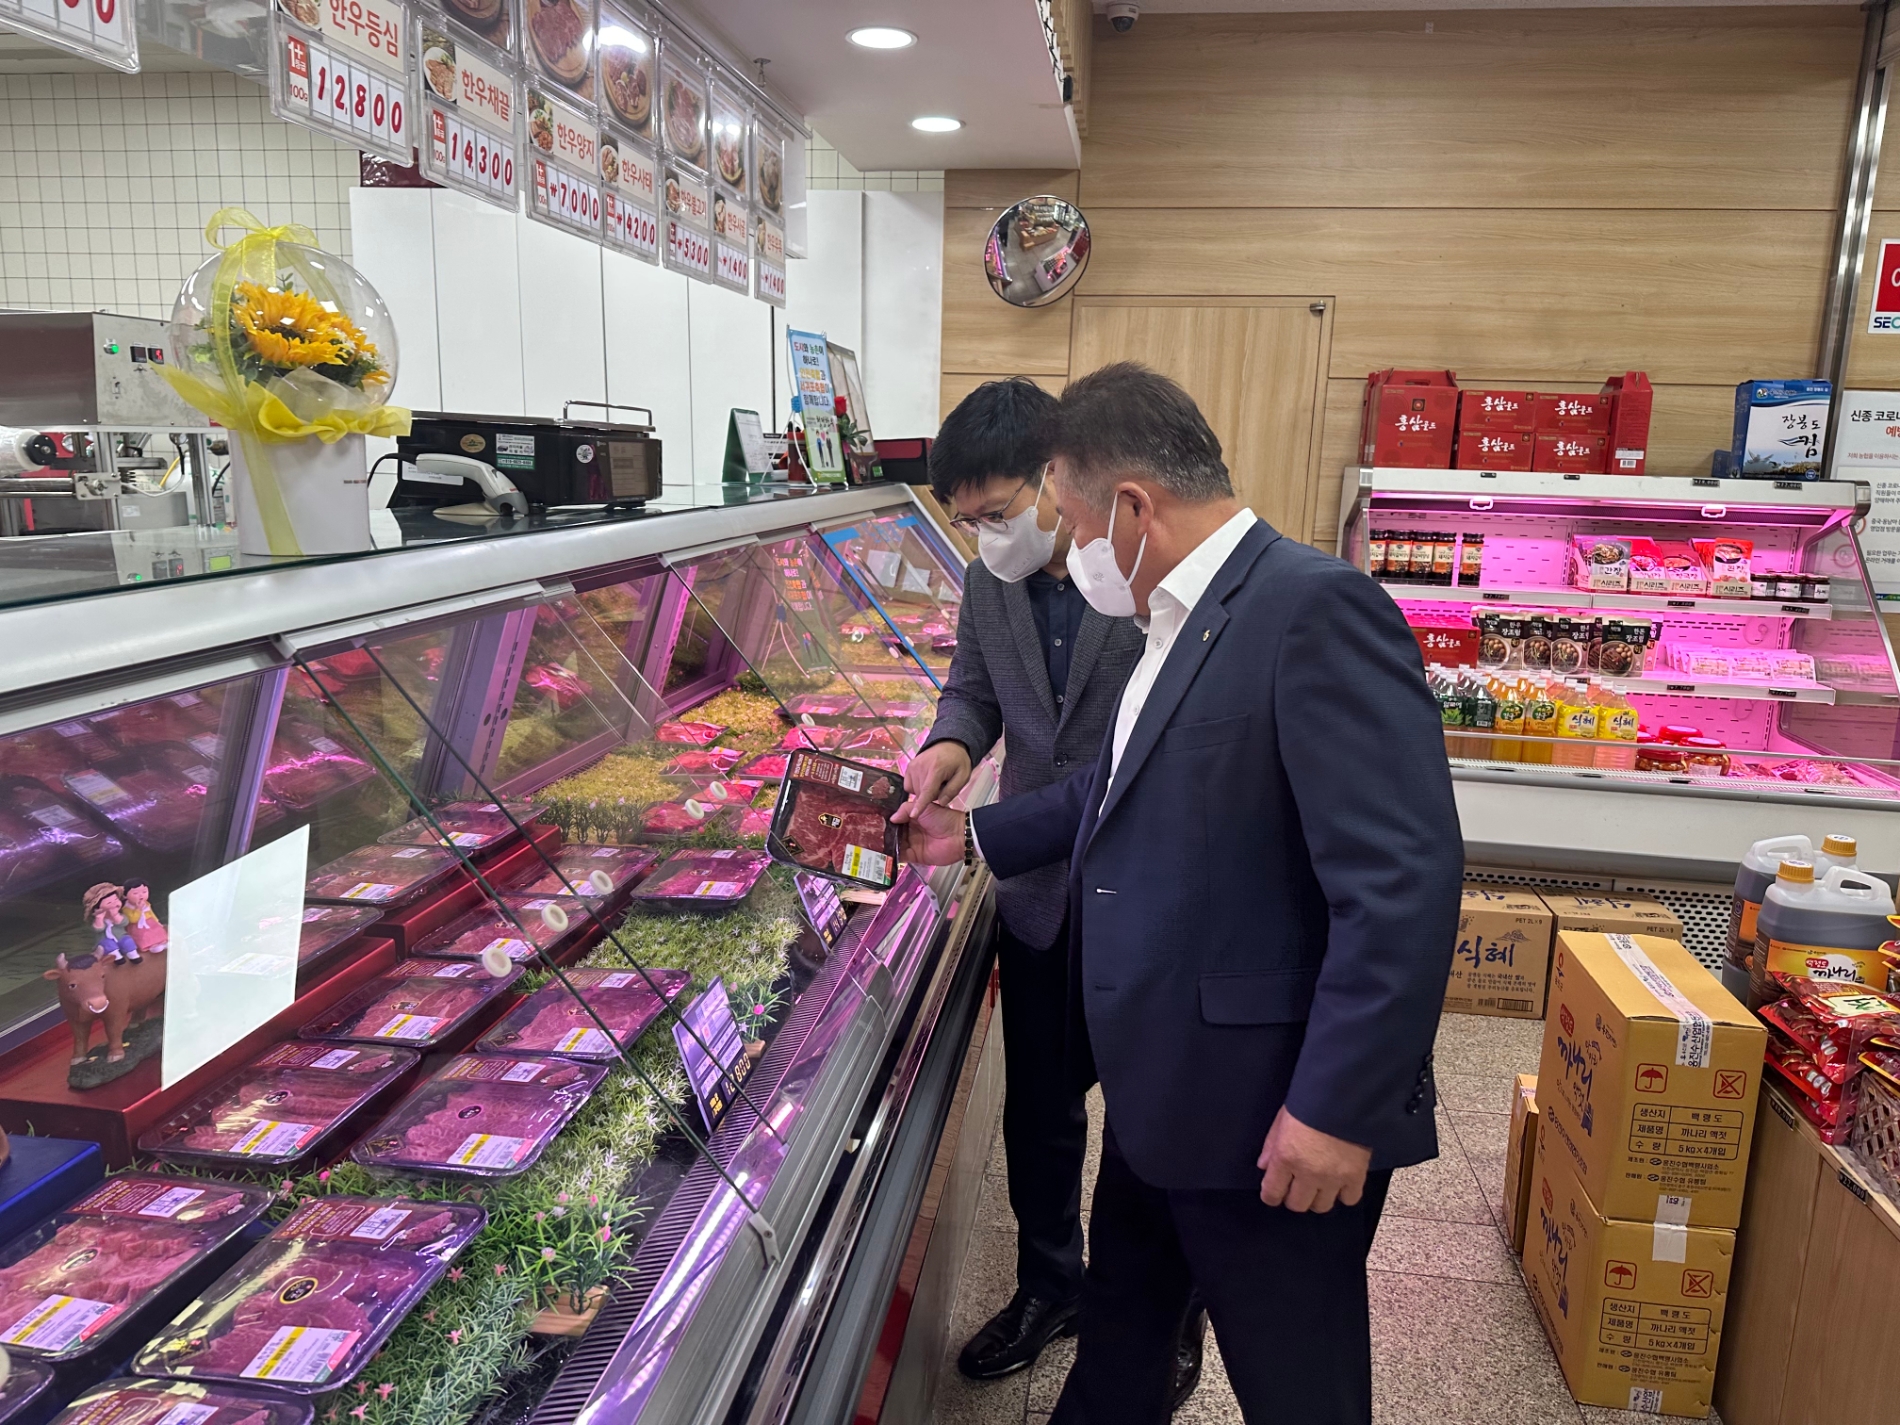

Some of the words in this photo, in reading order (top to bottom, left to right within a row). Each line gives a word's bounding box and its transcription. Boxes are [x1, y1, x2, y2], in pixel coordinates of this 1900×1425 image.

[461, 69, 510, 122] 한우채끝
[556, 122, 595, 165] 한우양지
[622, 157, 653, 195] 한우사태
[1782, 414, 1821, 430] 장봉도
[1850, 410, 1872, 422] 신종
[1798, 433, 1818, 459] 김
[1572, 714, 1596, 727] 식혜
[1612, 714, 1635, 727] 식혜
[1456, 935, 1516, 969] 식혜
[1813, 966, 1857, 982] 까나리
[1640, 1107, 1666, 1119] 생산지
[1637, 1123, 1664, 1135] 제품명
[1681, 1127, 1707, 1138] 까나리
[1709, 1130, 1727, 1140] 액젓
[1660, 1175, 1686, 1184] 옹진수협
[1609, 1302, 1635, 1313] 생산지
[1607, 1317, 1634, 1329] 제품명
[1650, 1323, 1676, 1333] 까나리
